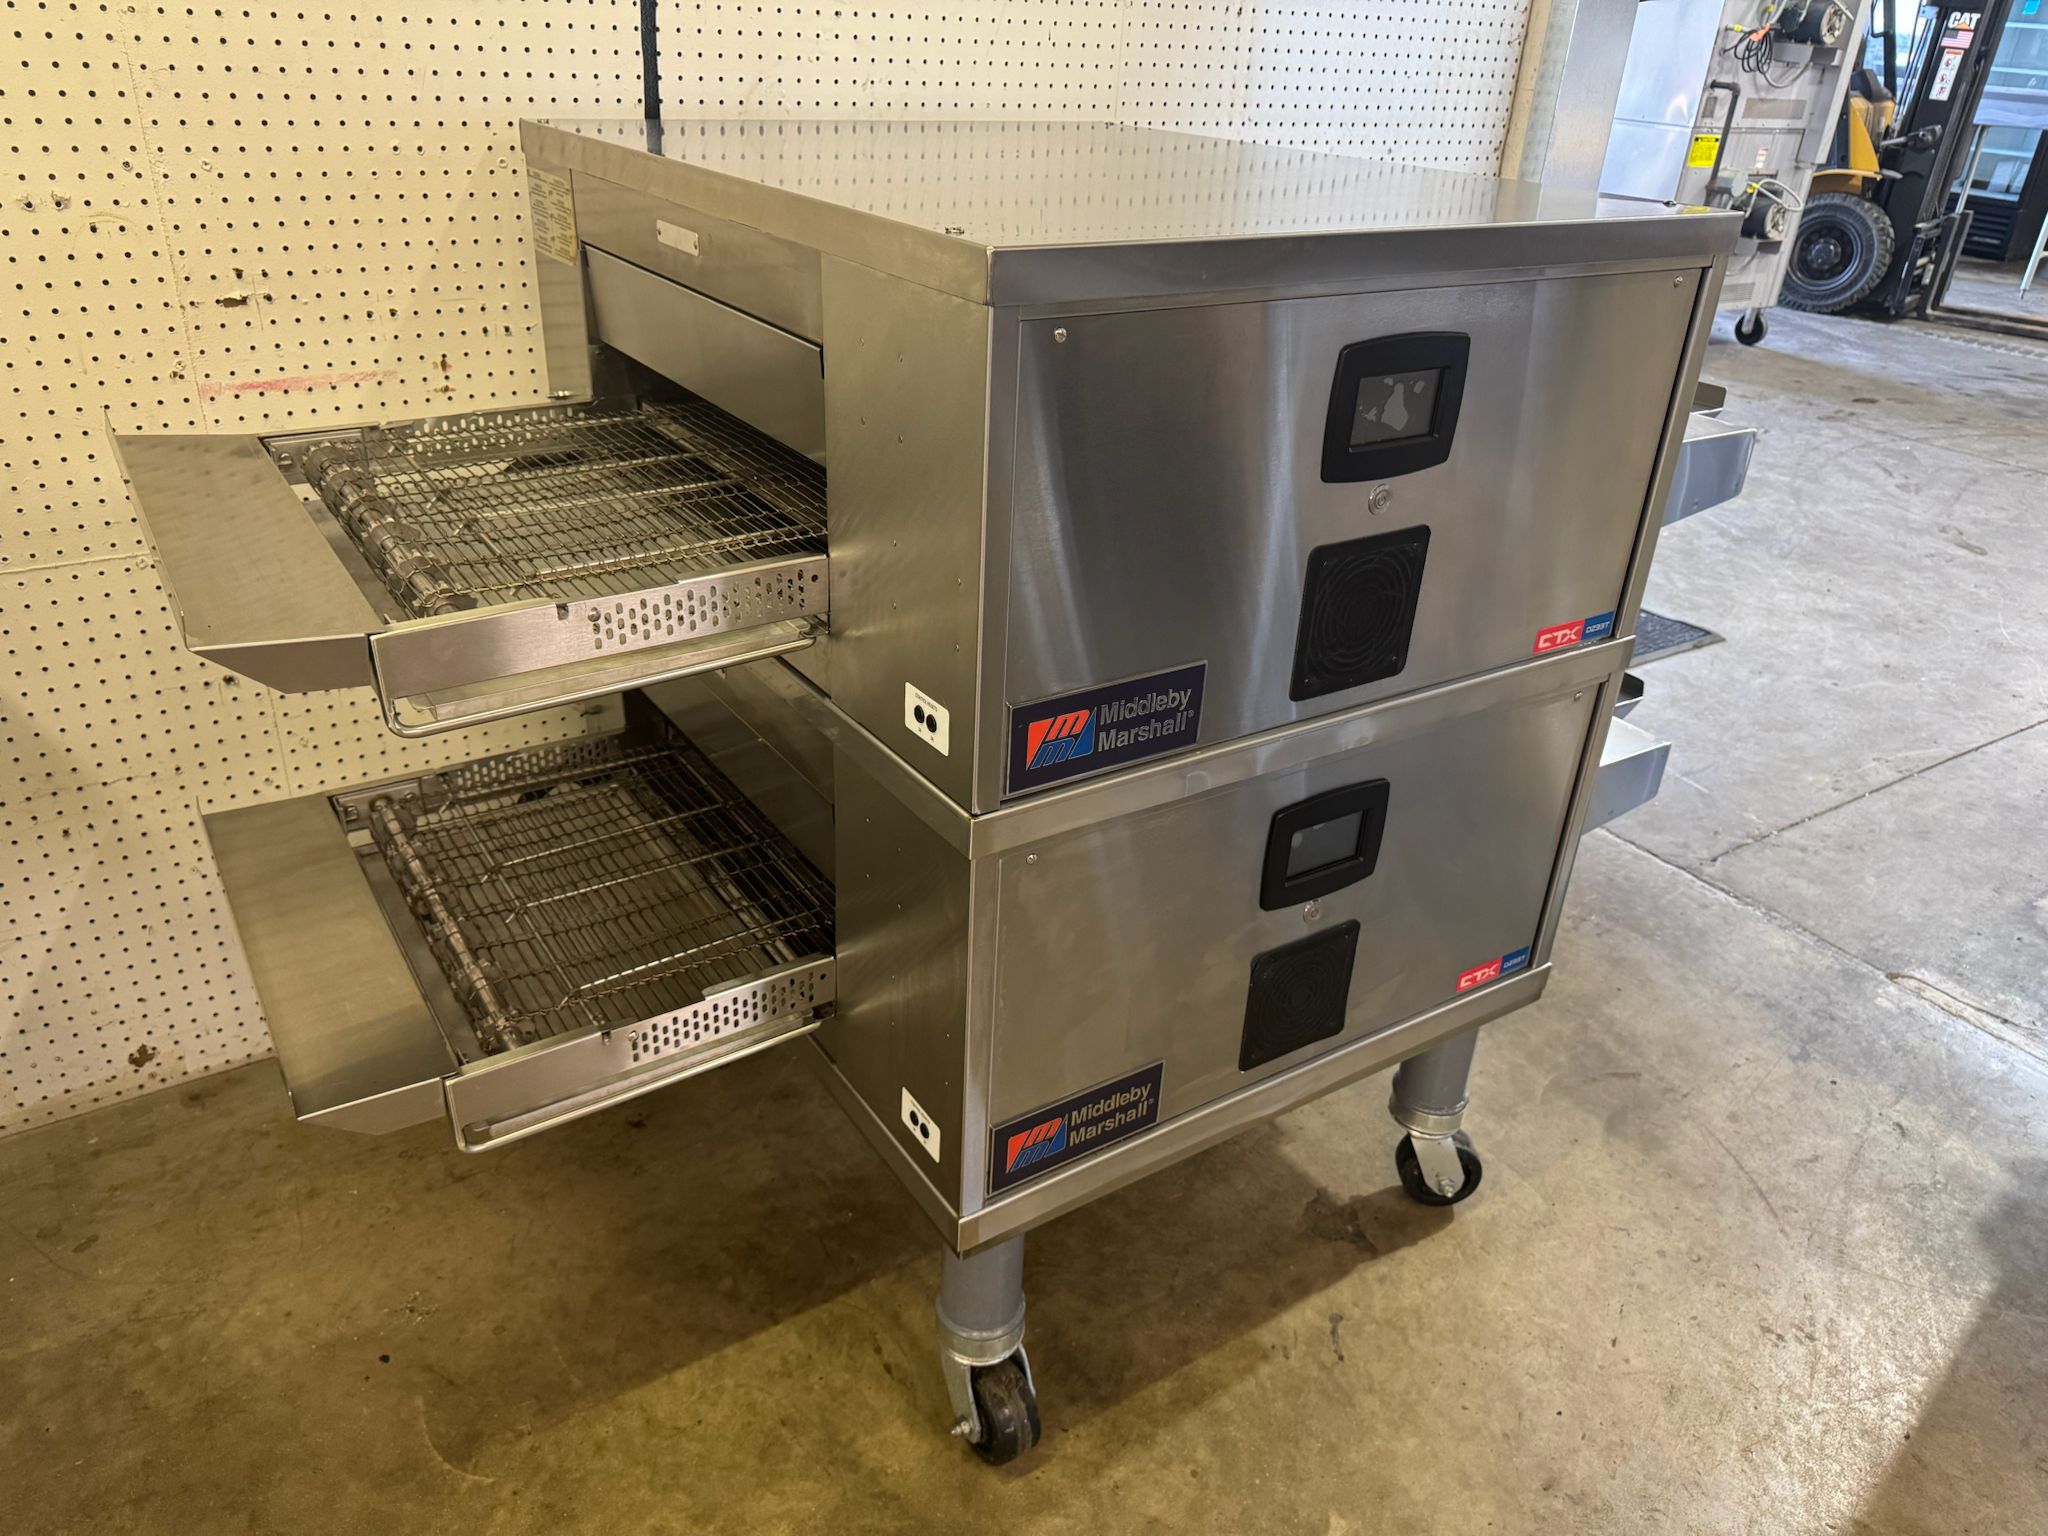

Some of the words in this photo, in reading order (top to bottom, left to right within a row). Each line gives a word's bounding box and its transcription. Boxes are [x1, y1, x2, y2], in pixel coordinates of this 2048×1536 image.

[1948, 11, 1981, 30] CAT
[1538, 626, 1582, 648] CTX
[1100, 688, 1192, 726] Middleby
[1460, 963, 1500, 988] CTX
[1071, 1083, 1152, 1126] Middleby
